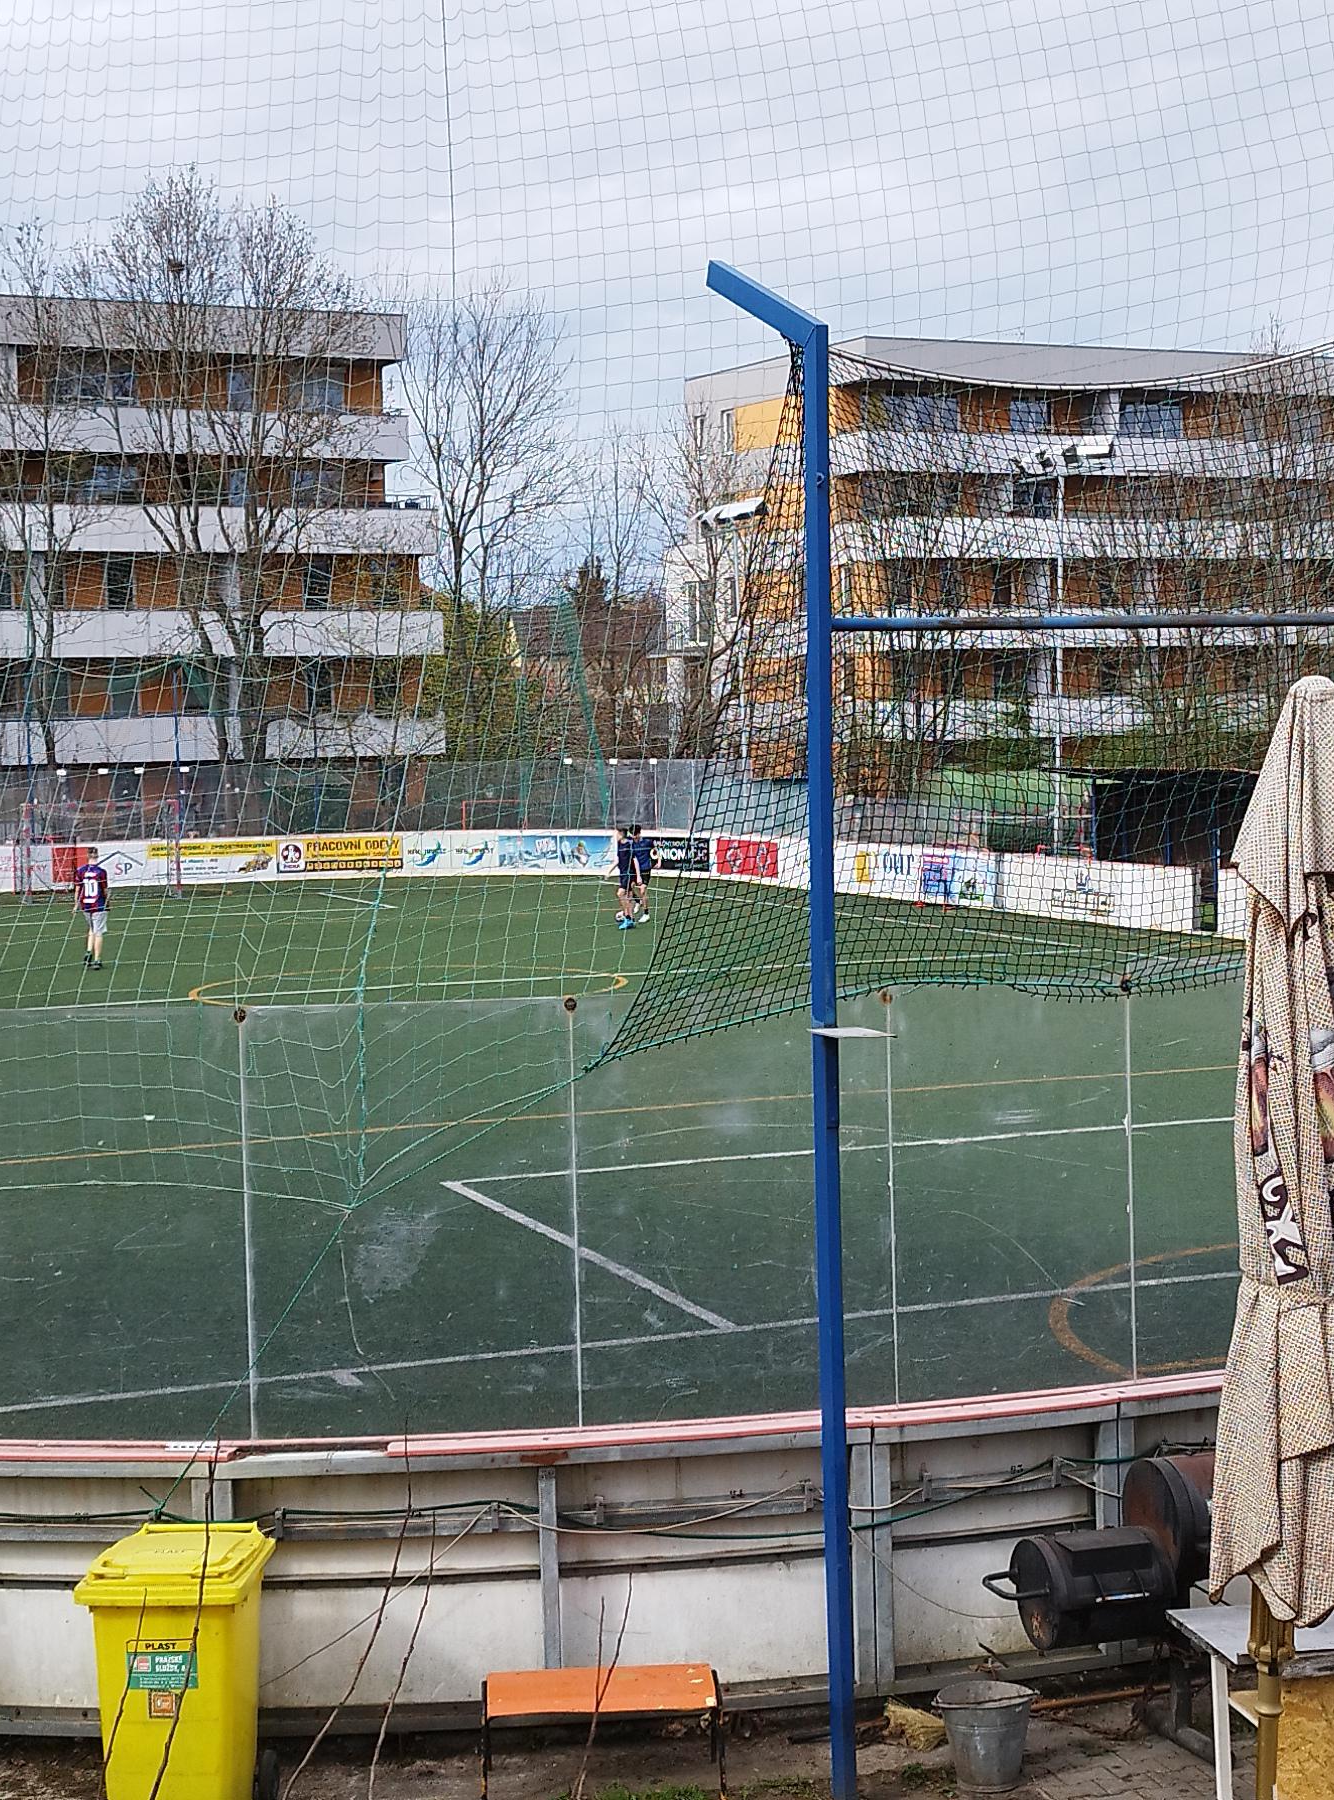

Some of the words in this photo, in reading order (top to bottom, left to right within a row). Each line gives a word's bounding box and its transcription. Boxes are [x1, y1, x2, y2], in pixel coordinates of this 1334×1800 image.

[114, 863, 133, 875] SP
[82, 878, 98, 897] 10
[145, 1642, 177, 1650] PLAST
